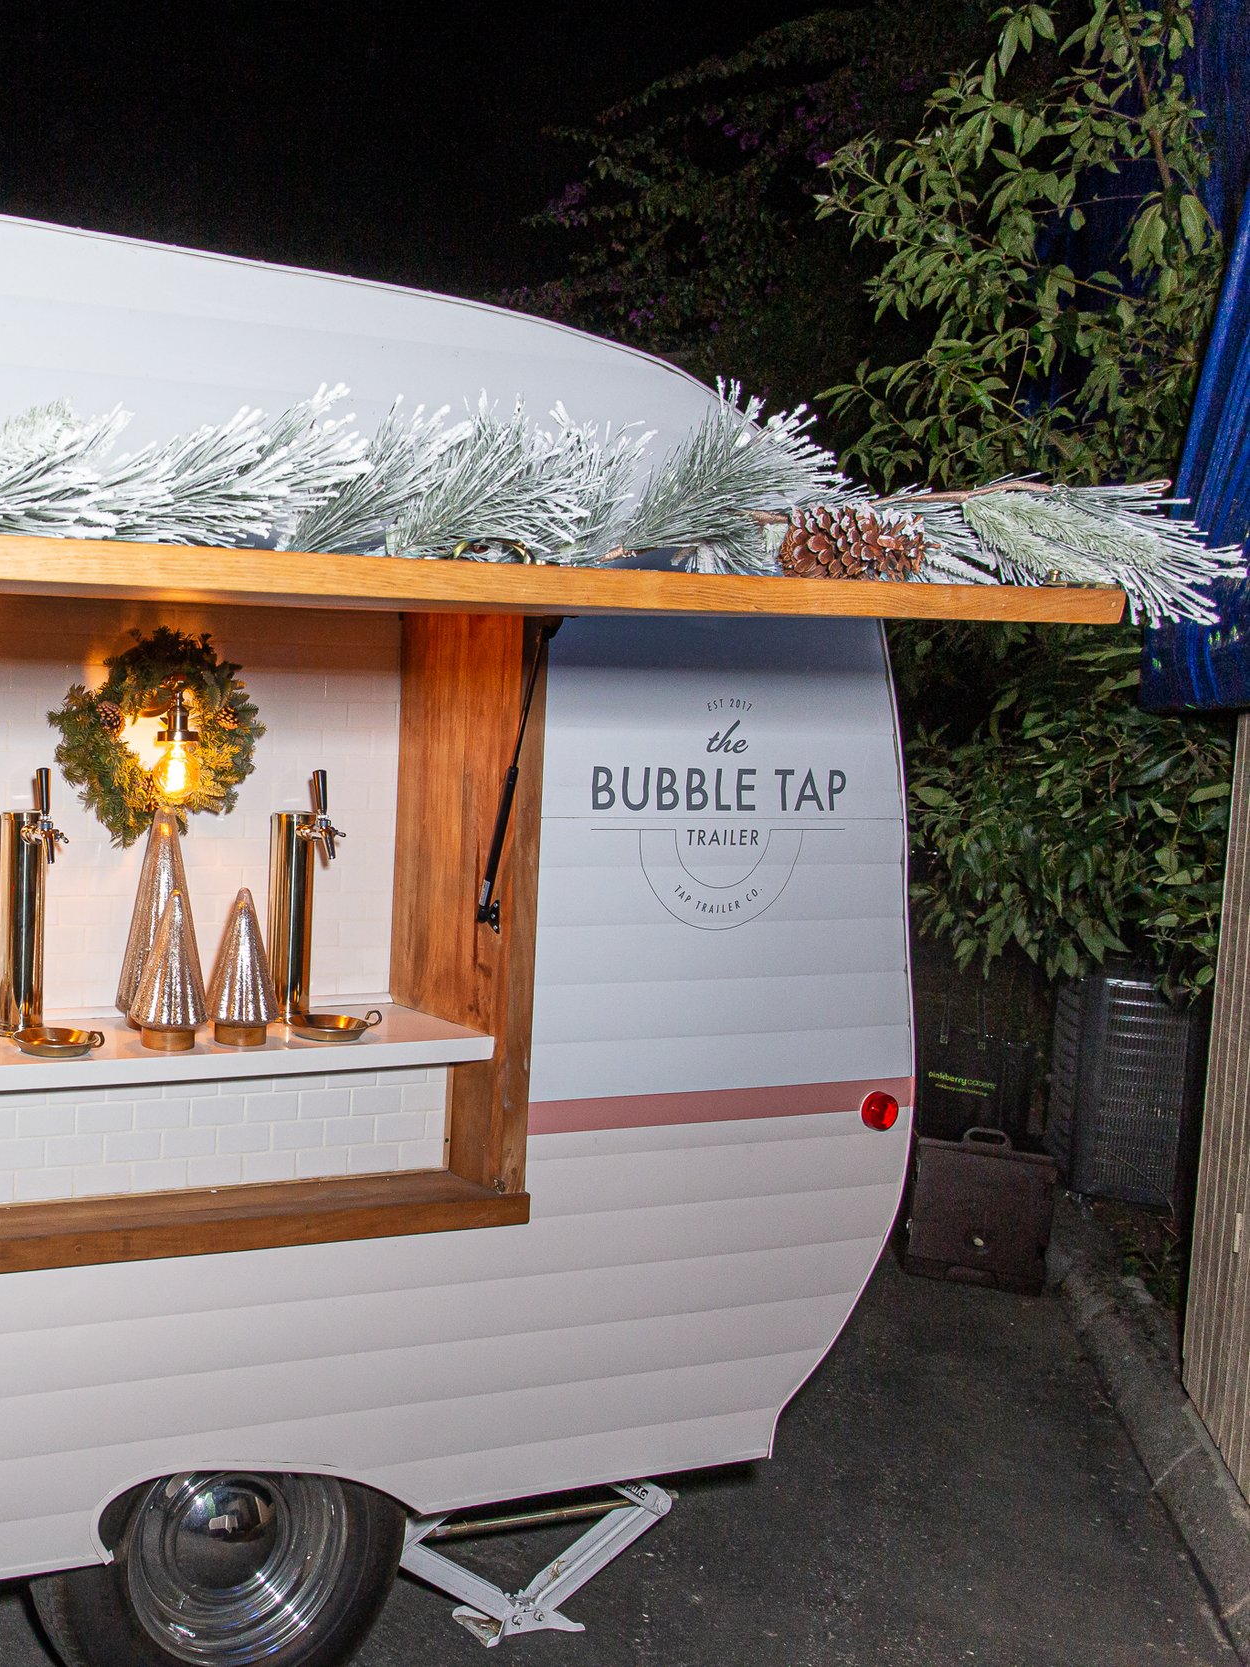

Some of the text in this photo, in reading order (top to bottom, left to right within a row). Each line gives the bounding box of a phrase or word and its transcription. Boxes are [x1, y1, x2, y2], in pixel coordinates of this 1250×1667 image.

[707, 697, 752, 711] EST 2017
[706, 719, 749, 754] the
[591, 766, 847, 812] BUBBLE TAP
[686, 829, 760, 846] TRAILER
[674, 884, 763, 914] TAP TRAILER CO.
